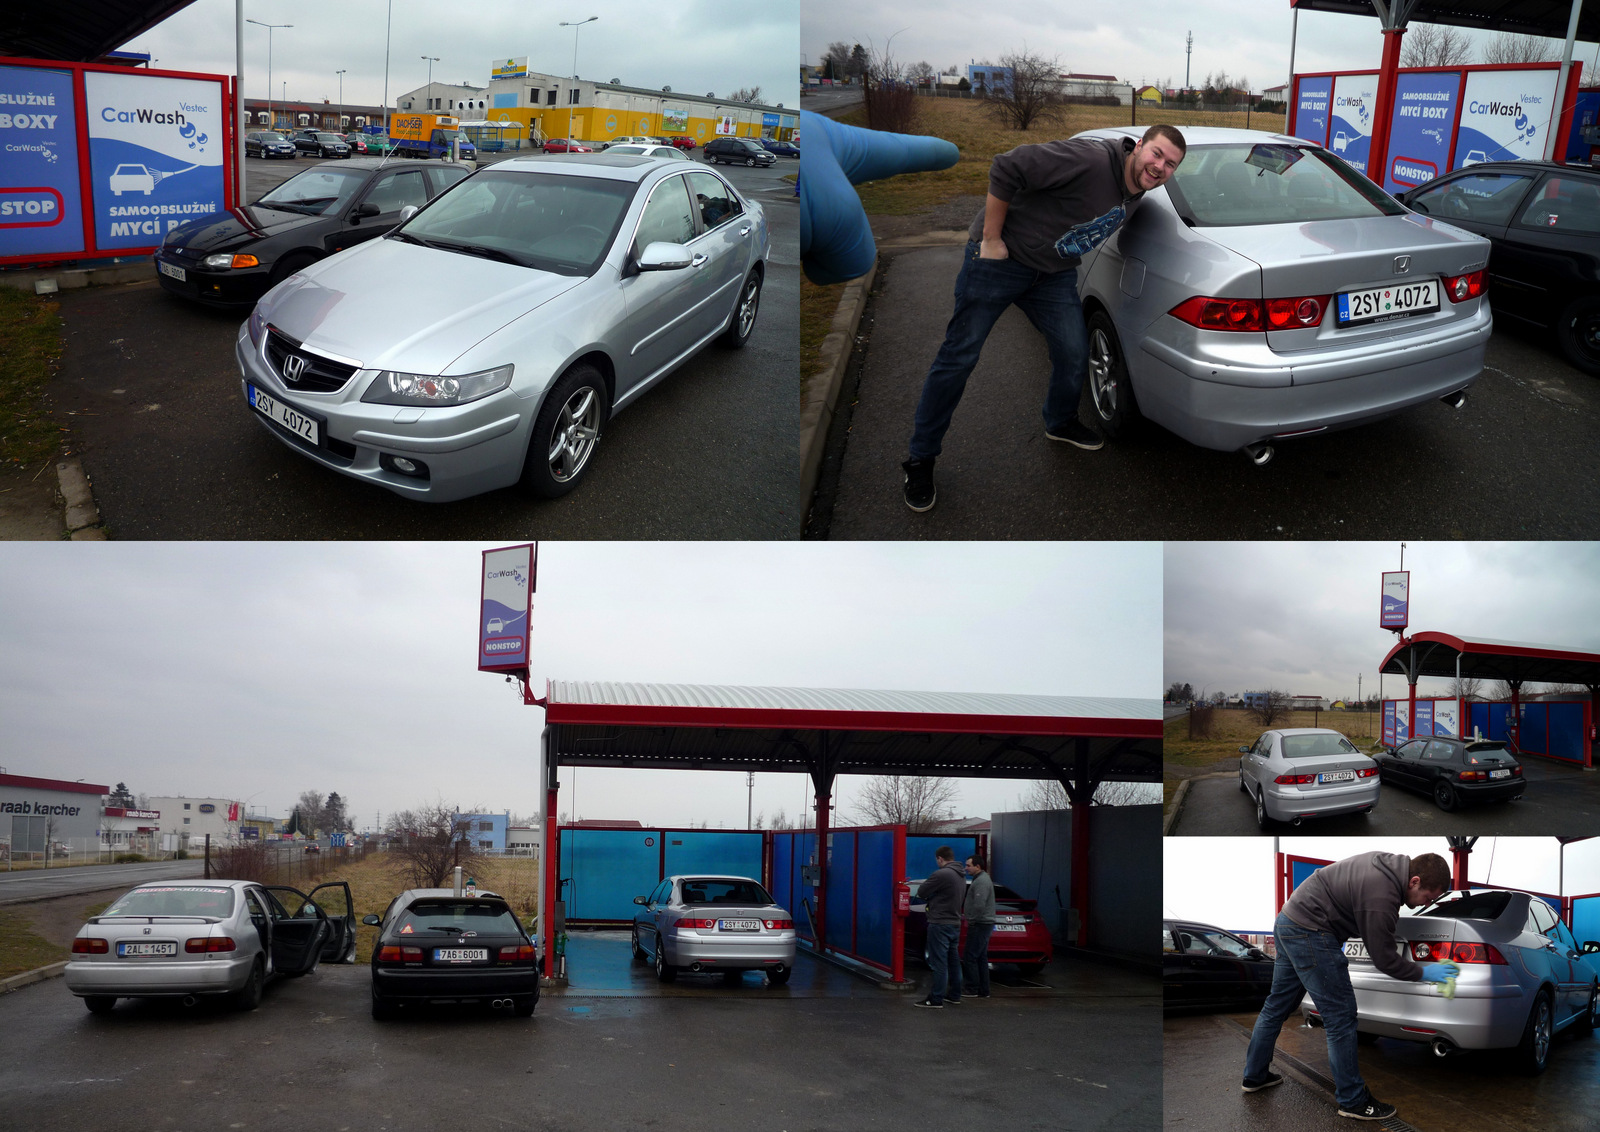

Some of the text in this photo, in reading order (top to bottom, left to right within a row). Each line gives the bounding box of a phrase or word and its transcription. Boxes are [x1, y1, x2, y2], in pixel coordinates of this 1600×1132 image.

[1337, 96, 1363, 107] CarWash
[1402, 91, 1450, 101] SAMOOBSLUŽNÉ
[1520, 94, 1542, 104] Vestec
[179, 102, 208, 113] Vestec
[1313, 101, 1327, 111] BOXY
[1400, 103, 1448, 119] MYCÍ BOXY
[1469, 100, 1522, 117] CarWash
[0, 113, 58, 129] BOXY
[101, 107, 185, 125] CarWash
[396, 119, 423, 129] DACHSER
[5, 144, 46, 152] CarWash
[1394, 165, 1434, 182] NONSTOP
[109, 201, 216, 216] SAMOOBSLUŽNÉ
[110, 216, 161, 237] MYCÍ
[1352, 284, 1431, 317] 2SY 4072
[1340, 311, 1349, 319] CZ
[256, 391, 313, 440] 2SY 4072
[487, 568, 518, 579] CarWash
[486, 641, 521, 651] NONSTOP
[0, 801, 81, 816] raab karcher
[139, 810, 159, 818] karcher
[126, 943, 172, 954] 2AL 1451
[1345, 943, 1365, 956] 2SY
[441, 950, 484, 959] 7A6 6001
